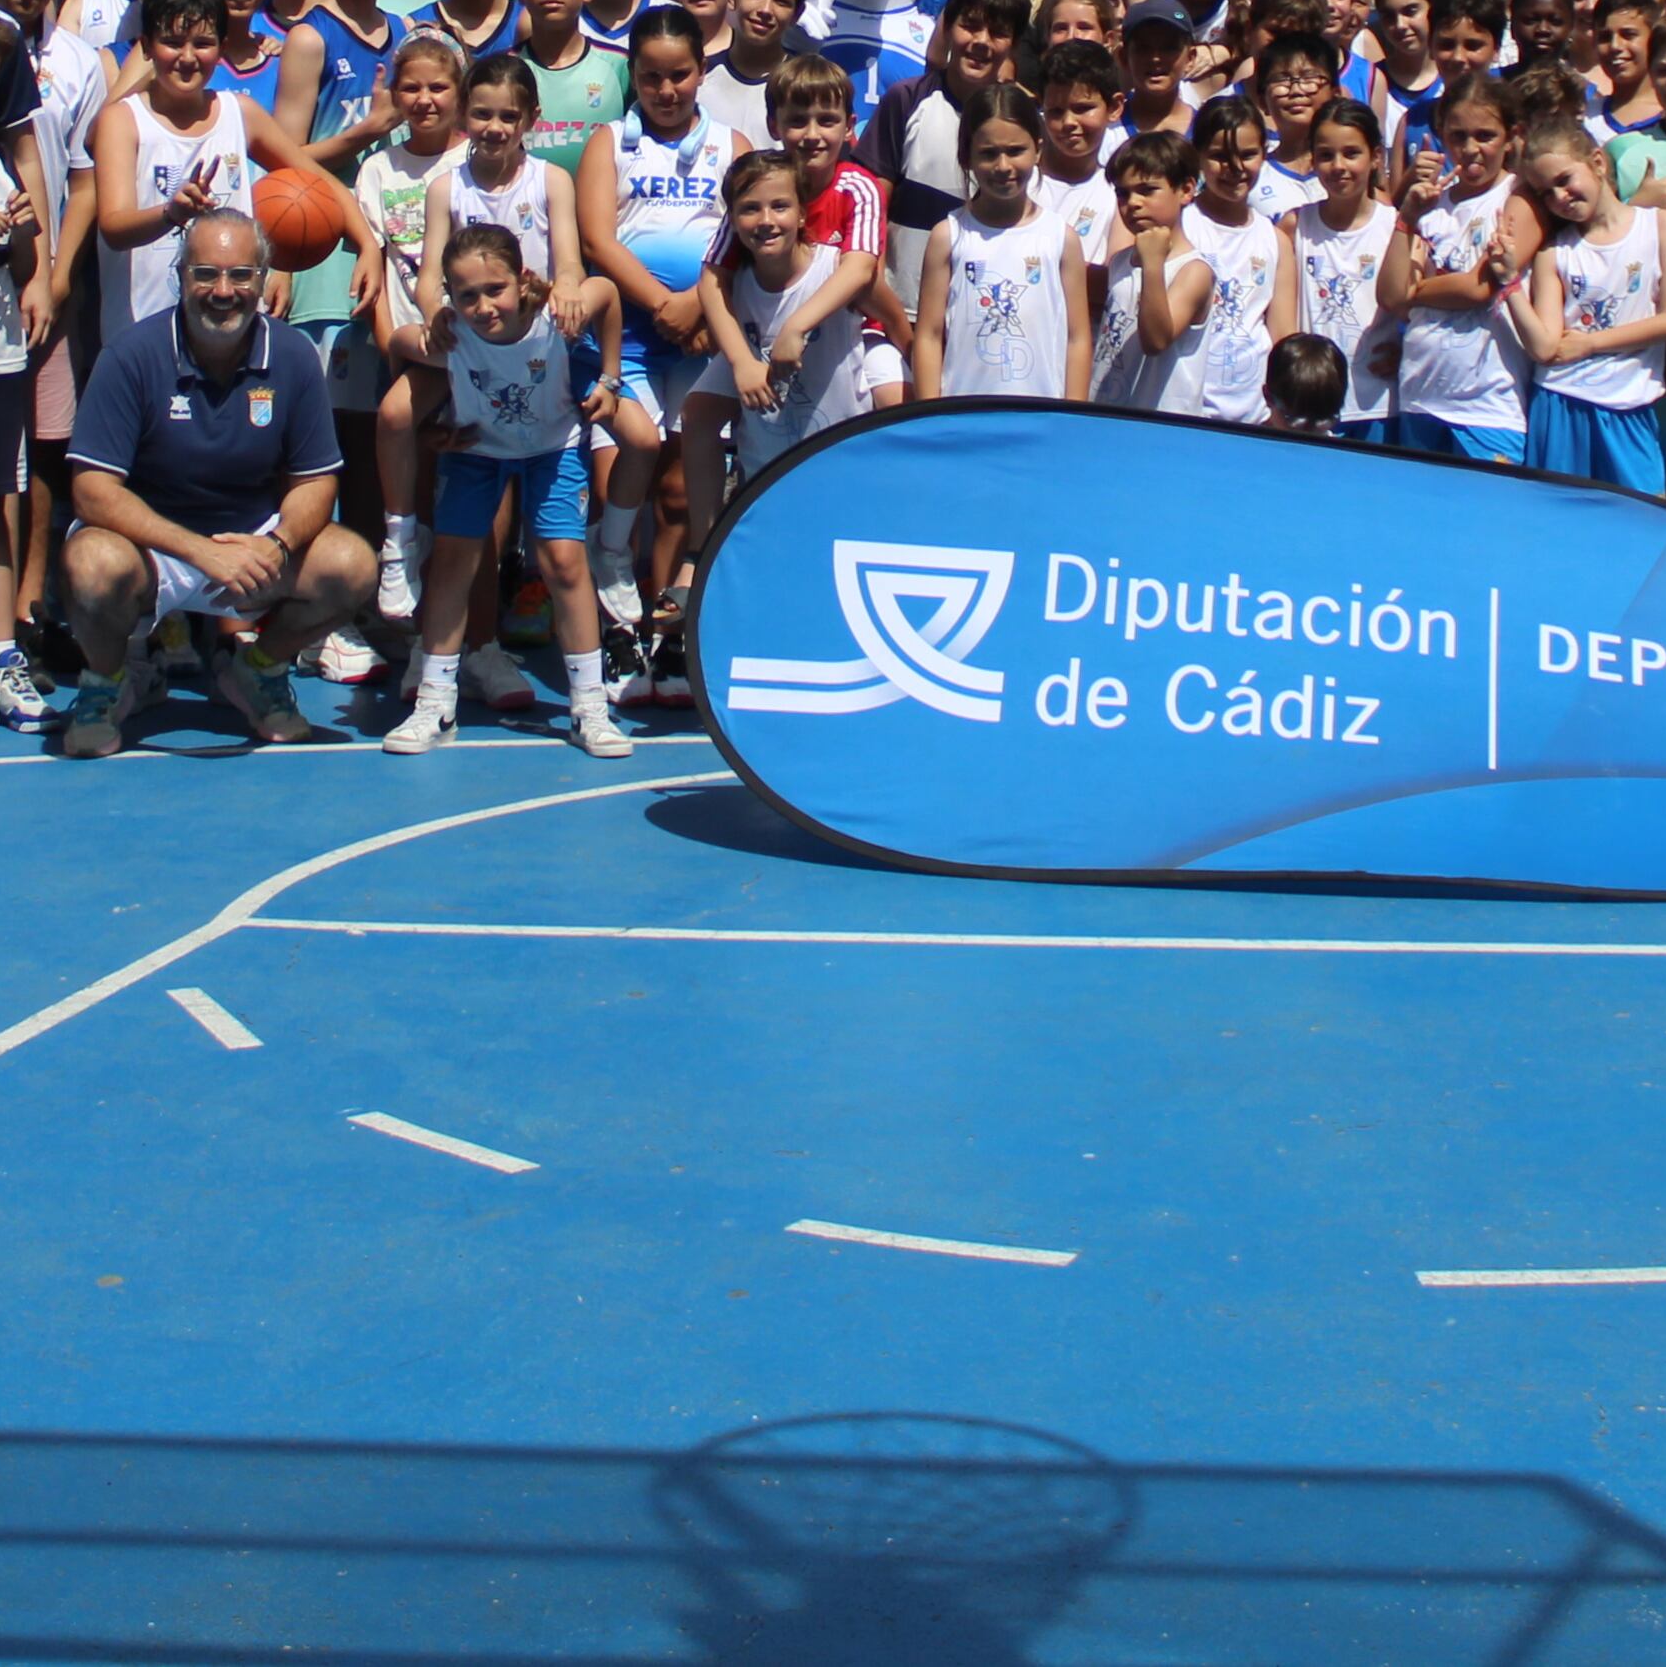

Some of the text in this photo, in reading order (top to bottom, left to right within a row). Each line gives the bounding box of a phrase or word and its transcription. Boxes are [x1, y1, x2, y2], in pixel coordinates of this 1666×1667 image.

[864, 56, 880, 105] 1
[628, 175, 717, 201] XEREZ
[1044, 553, 1456, 658] Diputación
[1036, 658, 1380, 744] de Cádiz
